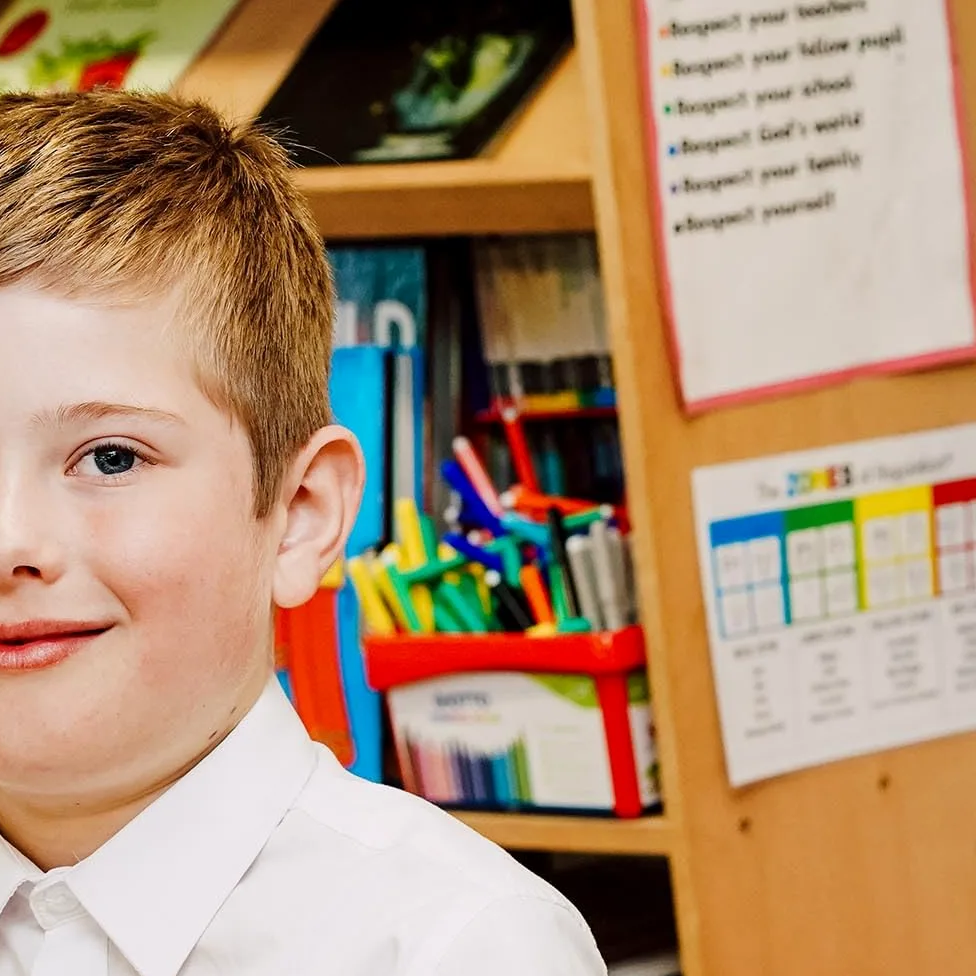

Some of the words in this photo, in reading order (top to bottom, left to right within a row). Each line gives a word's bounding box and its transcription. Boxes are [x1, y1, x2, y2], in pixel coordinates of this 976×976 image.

[750, 10, 787, 33] your
[753, 49, 790, 71] your
[756, 88, 793, 111] your
[761, 165, 797, 187] your
